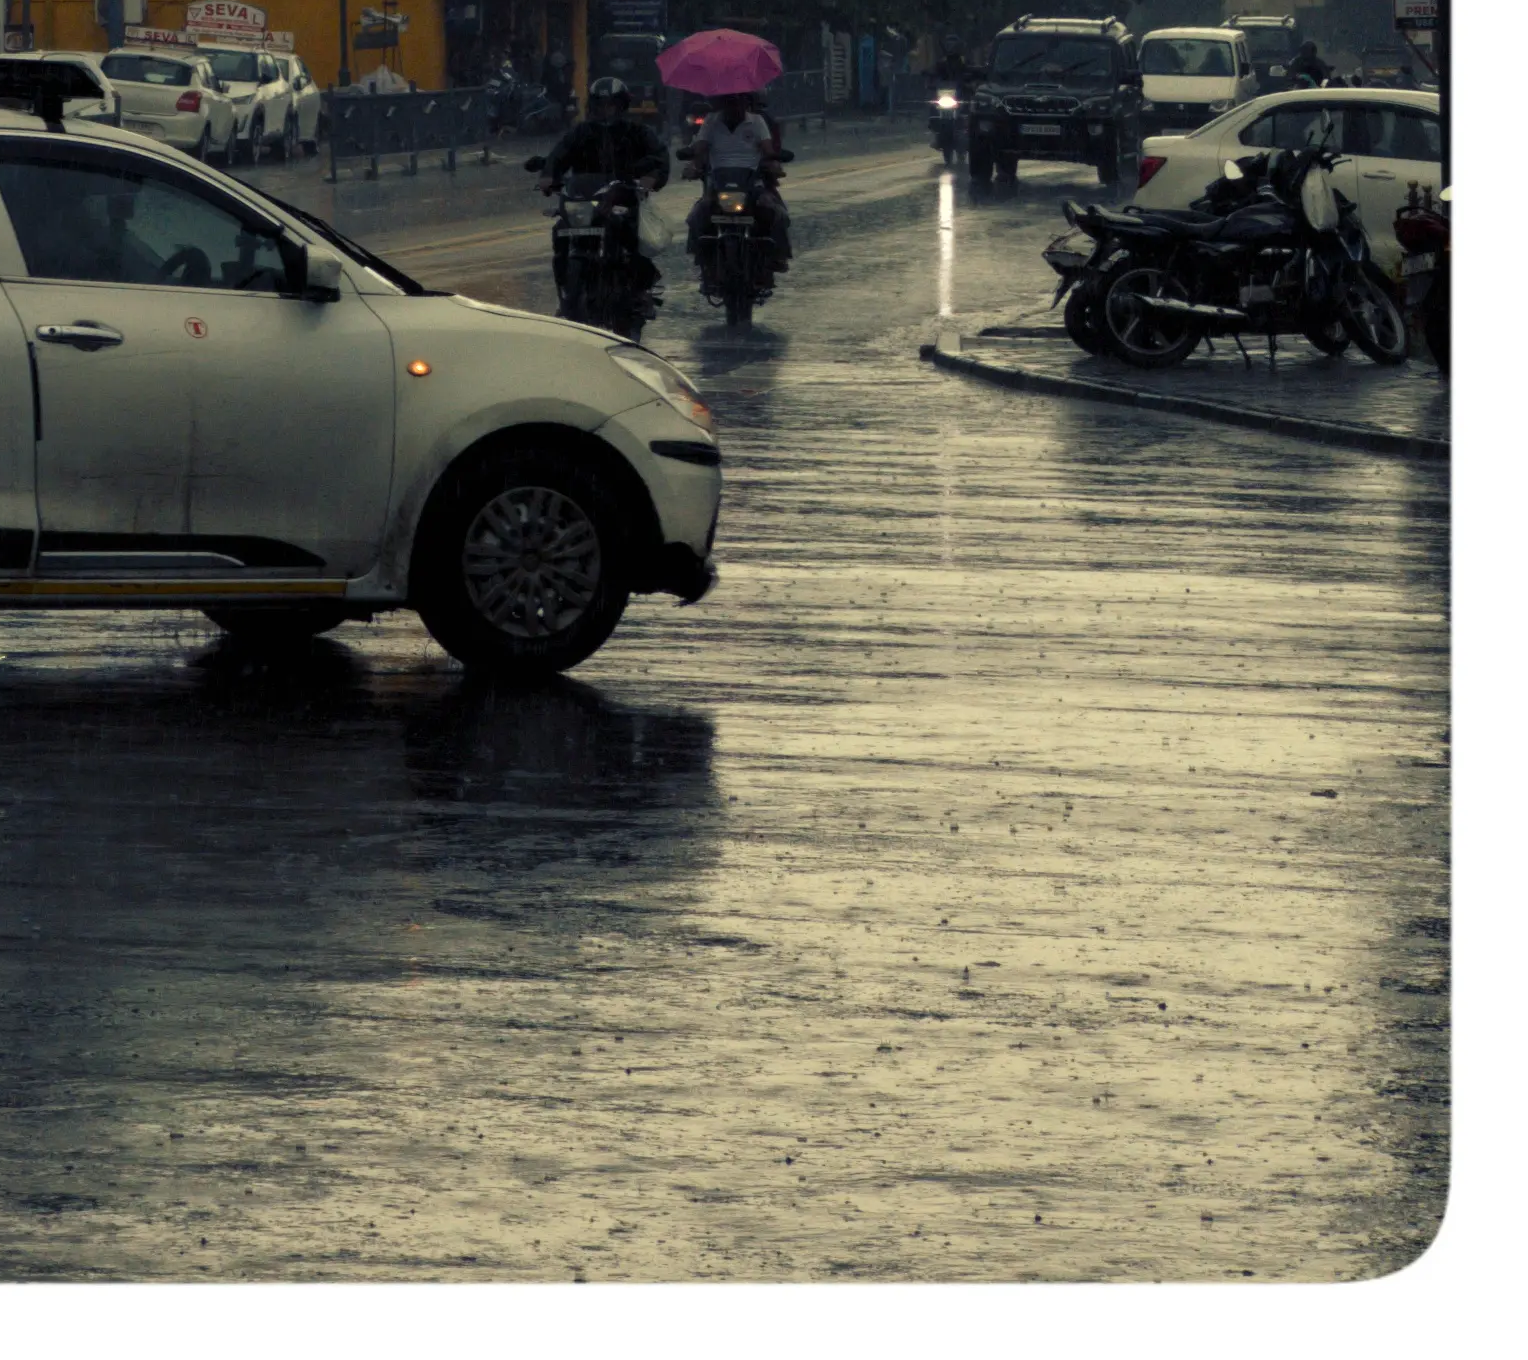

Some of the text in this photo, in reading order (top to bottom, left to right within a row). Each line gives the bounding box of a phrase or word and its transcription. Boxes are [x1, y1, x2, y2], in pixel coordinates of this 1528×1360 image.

[204, 3, 248, 20] SEVA
[144, 30, 179, 44] SEVA
[188, 322, 202, 335] T
